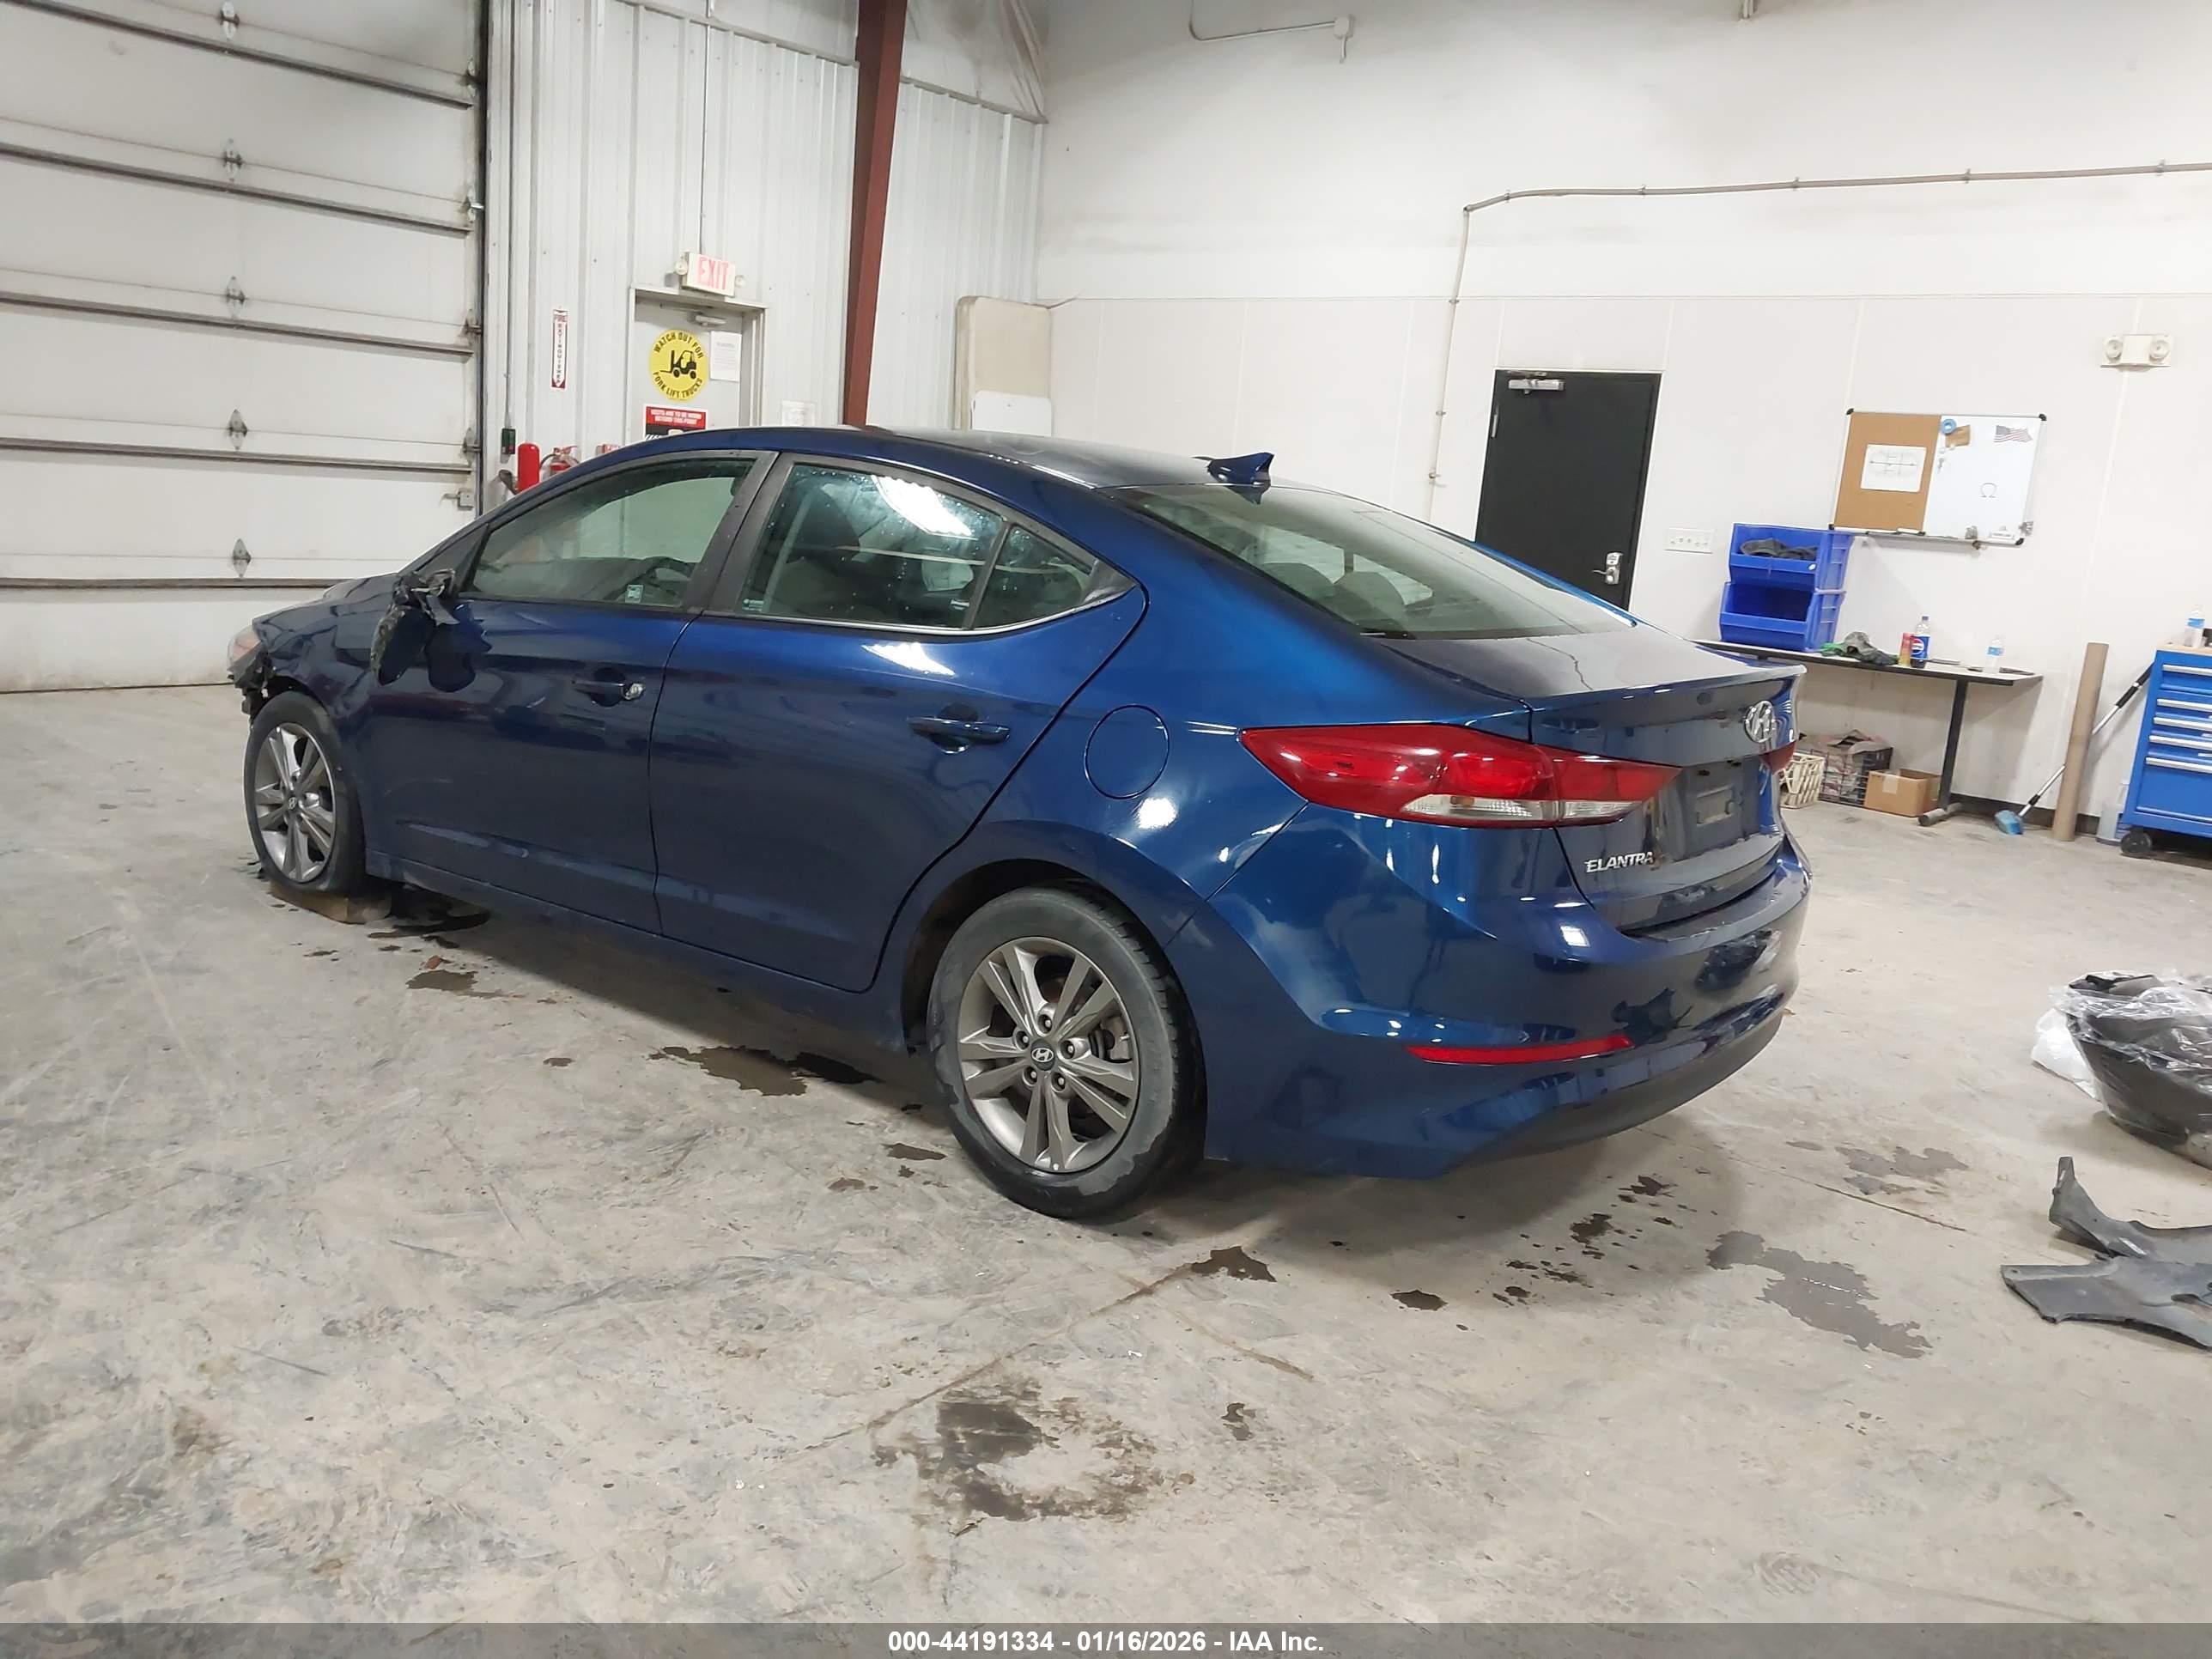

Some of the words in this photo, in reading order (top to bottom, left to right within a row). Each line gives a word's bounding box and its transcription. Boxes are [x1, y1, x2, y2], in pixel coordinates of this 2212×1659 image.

[698, 256, 729, 290] EXIT
[653, 331, 677, 353] WATCH
[678, 331, 693, 344] OUT
[692, 342, 704, 359] FOR
[653, 371, 665, 392] FORK
[665, 386, 680, 398] LIFT
[682, 377, 702, 398] TRUCKS
[1583, 851, 1653, 873] ELANTRA
